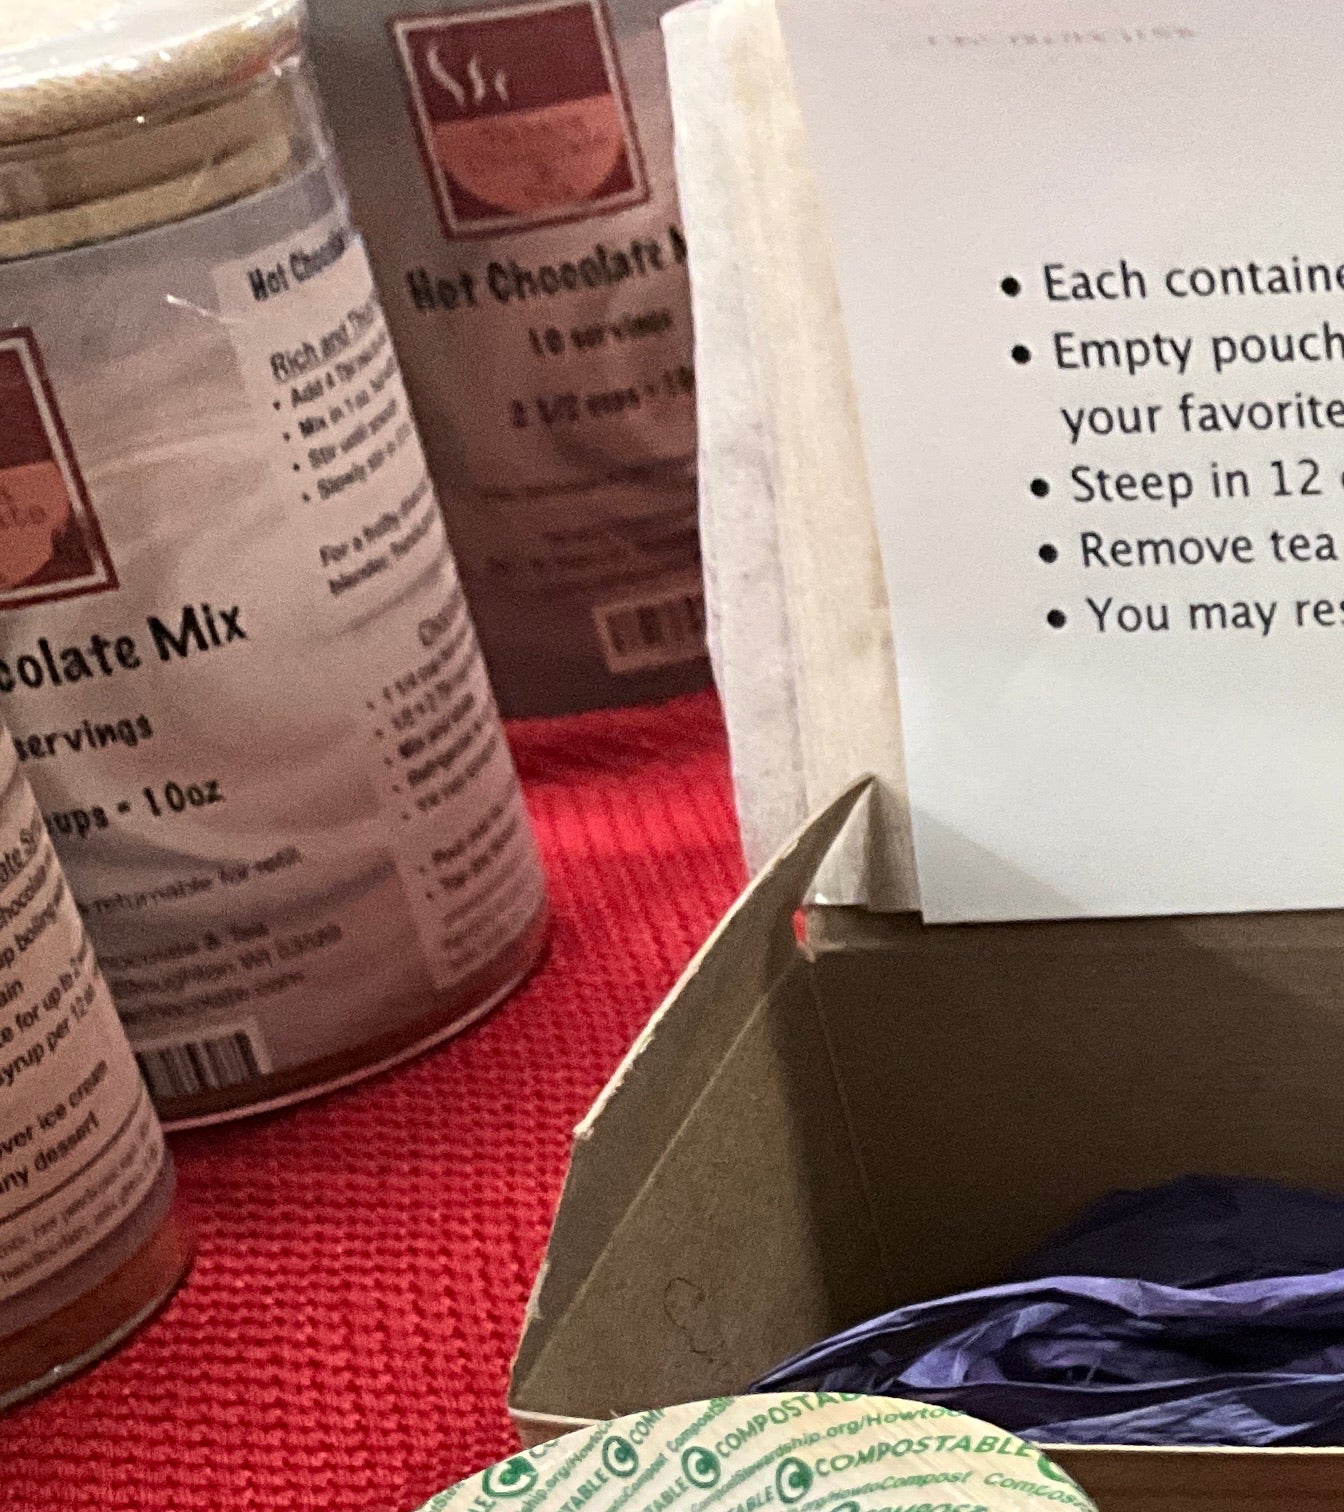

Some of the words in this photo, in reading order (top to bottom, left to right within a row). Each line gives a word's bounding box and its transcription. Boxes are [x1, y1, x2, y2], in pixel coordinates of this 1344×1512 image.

[1044, 261, 1146, 302] Each
[1054, 330, 1192, 375] Empty
[1061, 398, 1161, 444] your
[1071, 466, 1192, 508] Steep
[1212, 462, 1249, 499] in
[1271, 459, 1320, 497] 12
[1081, 531, 1253, 568] Remove
[1271, 529, 1336, 562] tea
[147, 602, 249, 662] Mix
[1086, 597, 1170, 634] You
[1190, 599, 1277, 636] may
[815, 1434, 1034, 1478] COMPOSTABLE
